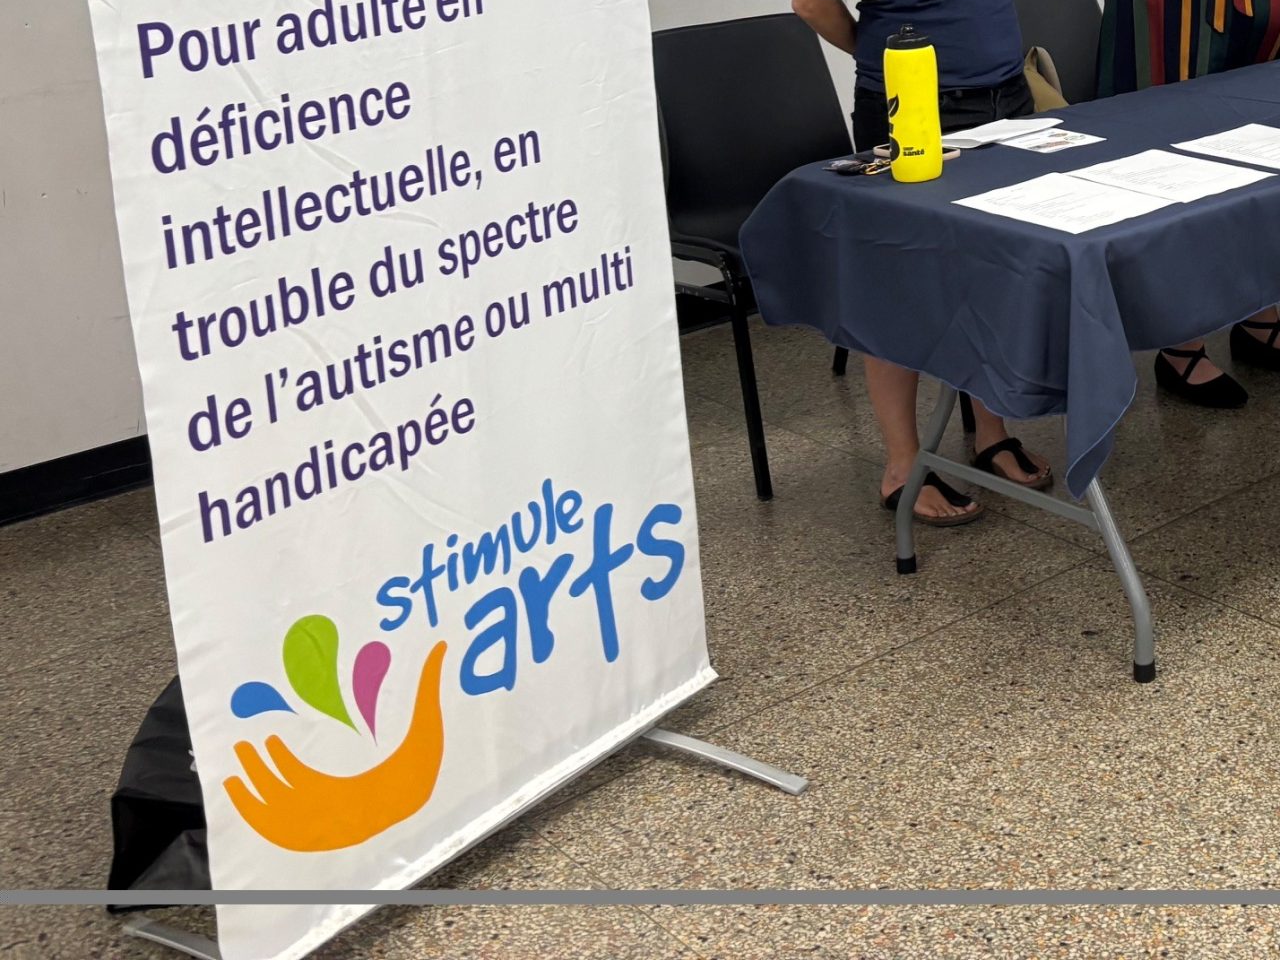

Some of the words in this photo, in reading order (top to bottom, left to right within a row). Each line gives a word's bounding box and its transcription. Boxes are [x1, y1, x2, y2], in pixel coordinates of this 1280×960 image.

[137, 18, 261, 79] Pour
[151, 81, 411, 174] déficience
[161, 144, 483, 270] intellectuelle,
[494, 130, 541, 173] en
[172, 267, 355, 361] trouble
[369, 245, 424, 298] du
[438, 199, 578, 279] spectre
[188, 394, 252, 452] de
[265, 315, 475, 423] l'autisme
[485, 292, 530, 338] ou
[542, 246, 634, 317] multi
[198, 394, 475, 543] handicapée
[377, 478, 584, 631] stimule
[460, 504, 685, 696] arts
